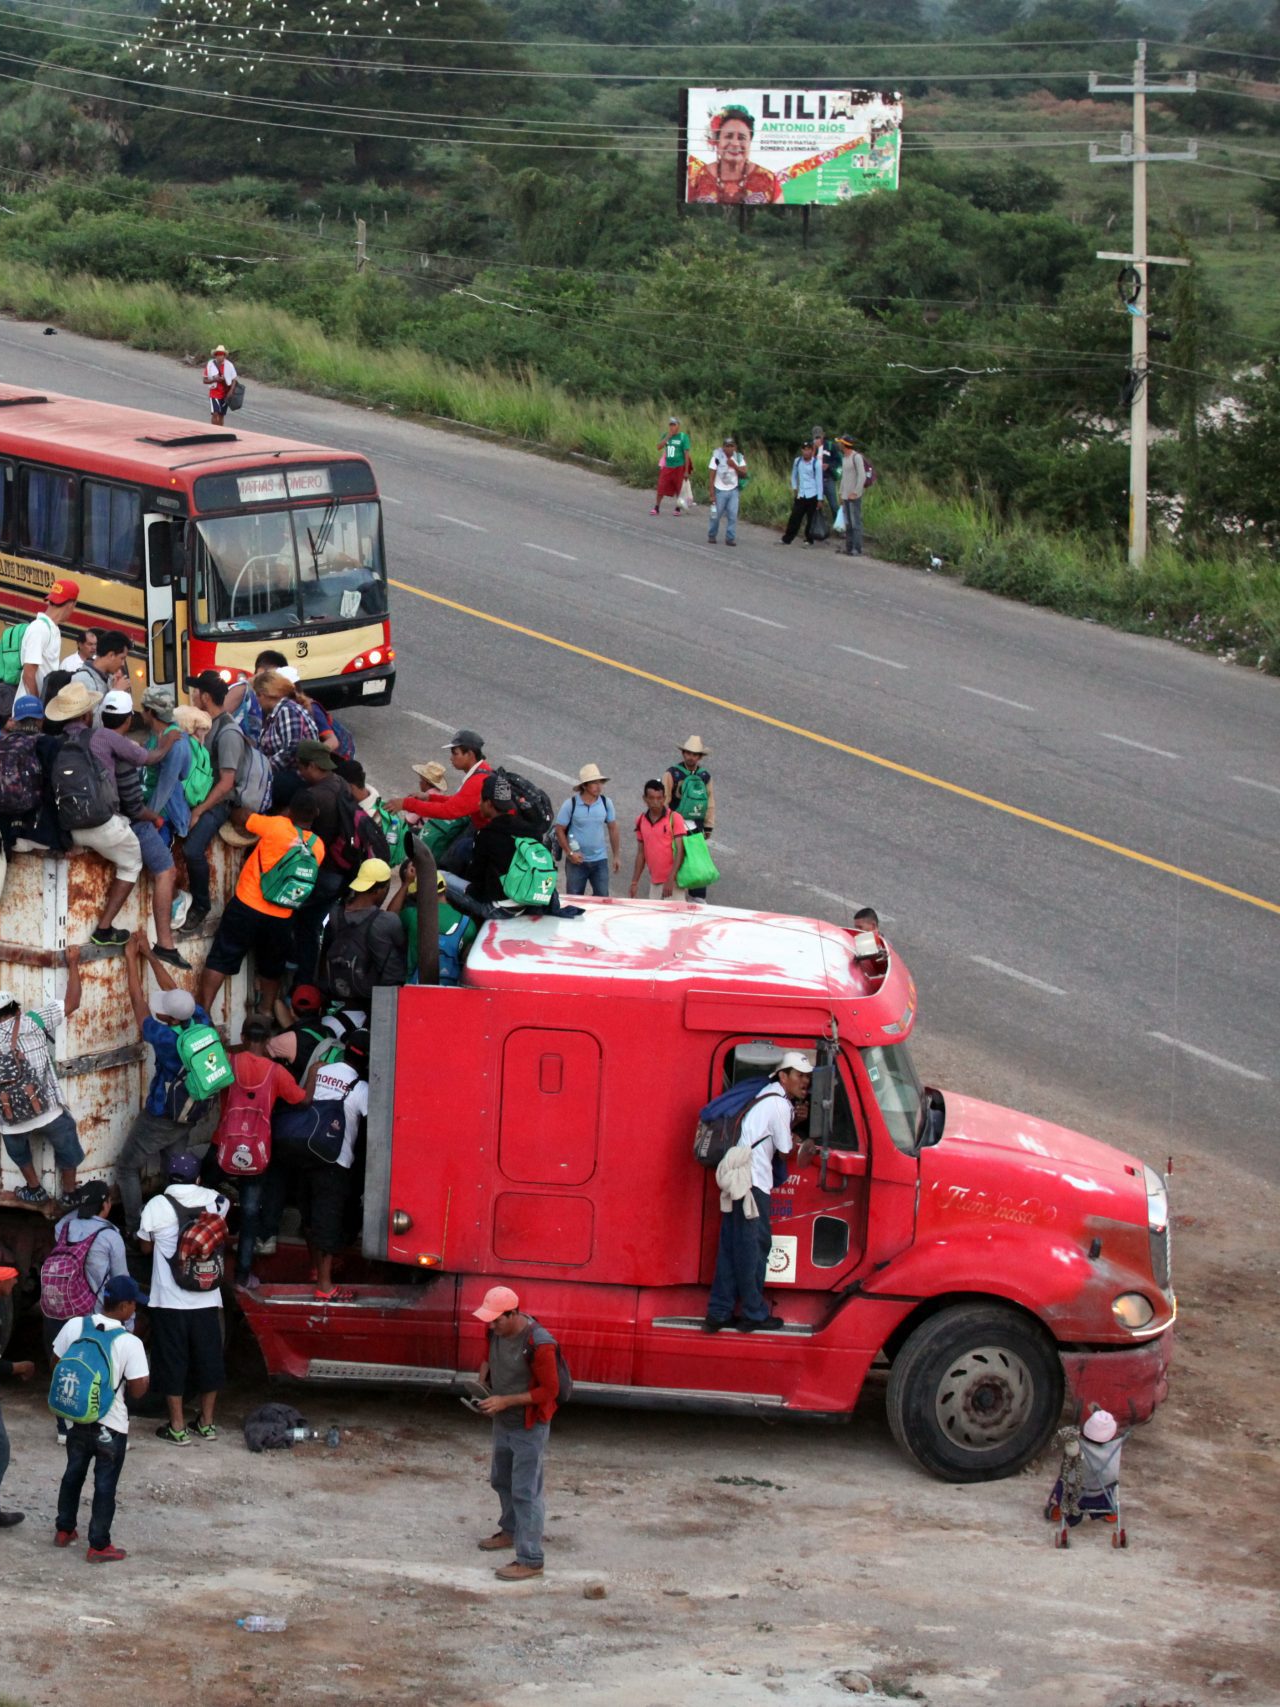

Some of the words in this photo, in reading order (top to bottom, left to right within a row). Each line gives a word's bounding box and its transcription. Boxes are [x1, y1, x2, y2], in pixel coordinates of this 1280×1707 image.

[761, 122, 815, 133] ANTONIO
[818, 120, 846, 133] RÍOS
[667, 445, 676, 458] 10
